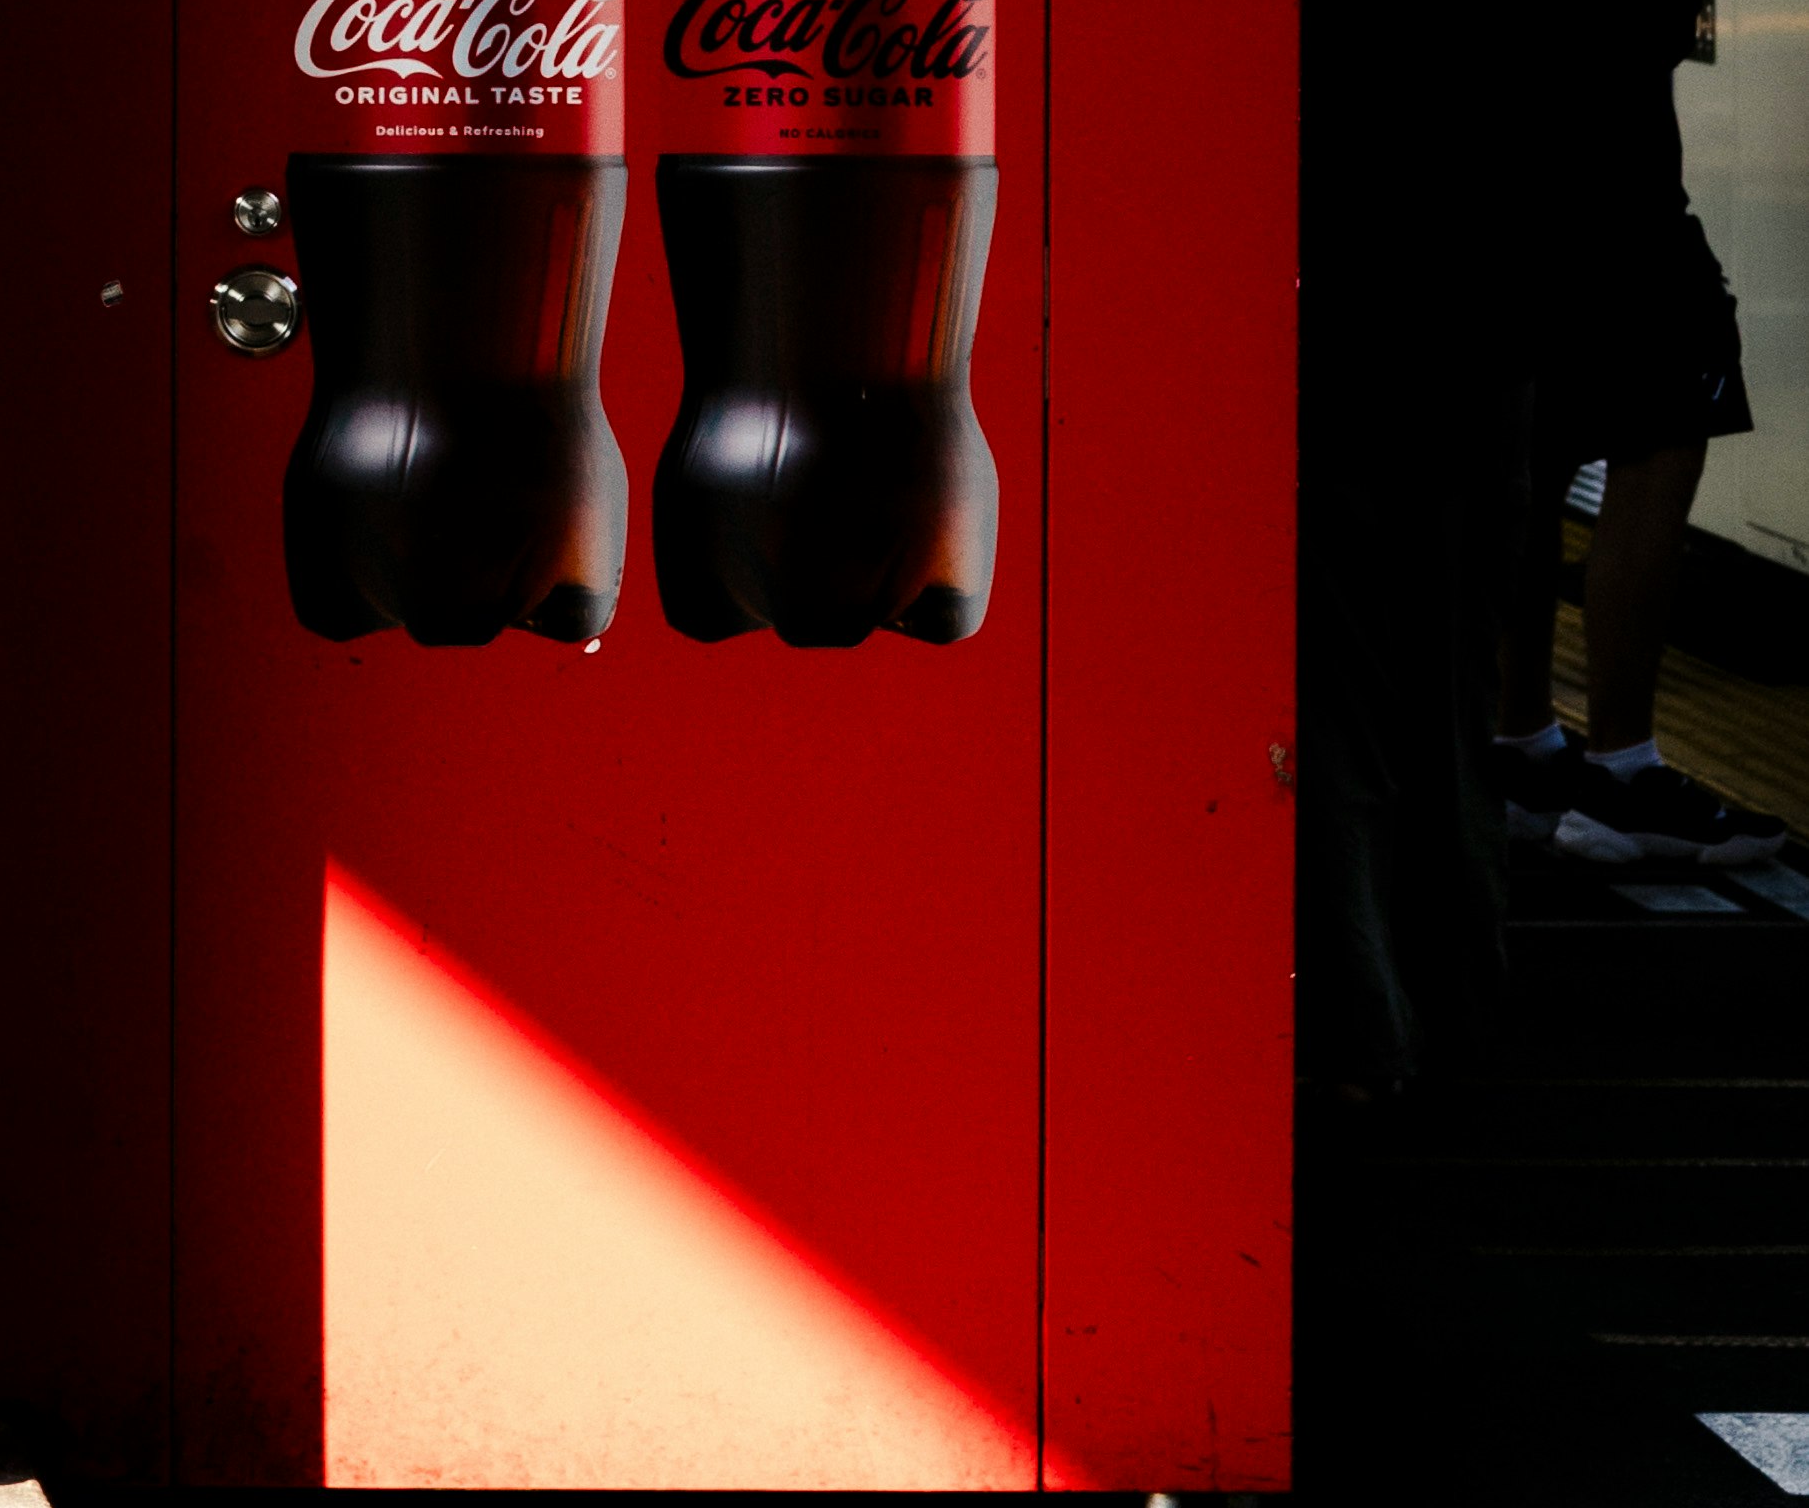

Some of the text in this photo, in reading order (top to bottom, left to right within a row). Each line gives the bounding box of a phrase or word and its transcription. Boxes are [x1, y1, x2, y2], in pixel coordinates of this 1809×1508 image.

[335, 86, 583, 105] ORIGINAL TASTE
[723, 86, 934, 107] ZERO SUGAR
[375, 125, 545, 139] Delicious & Refreshing
[779, 128, 801, 139] NO
